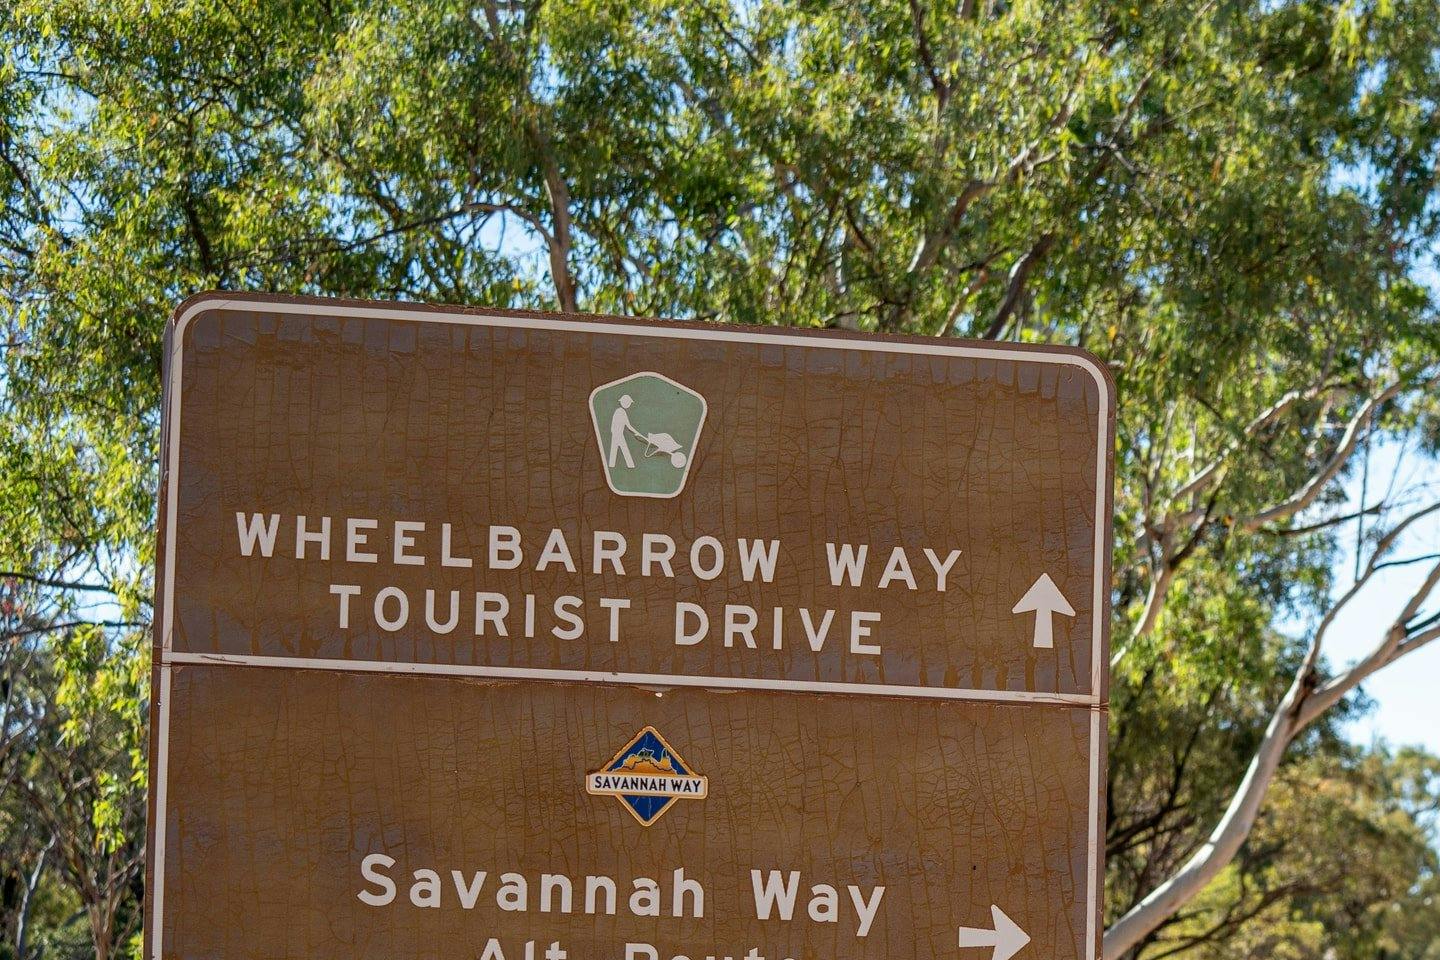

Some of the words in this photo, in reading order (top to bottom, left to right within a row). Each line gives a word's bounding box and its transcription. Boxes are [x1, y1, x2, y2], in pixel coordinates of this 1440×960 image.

[236, 512, 781, 583] WHEELBARROW
[826, 543, 963, 592] WAY
[328, 584, 631, 643] TOURIST
[675, 601, 884, 656] DRIVE
[594, 775, 667, 792] SAVANNAH
[671, 779, 701, 793] WAY
[357, 852, 705, 919] Savannah
[751, 868, 886, 937] Way
